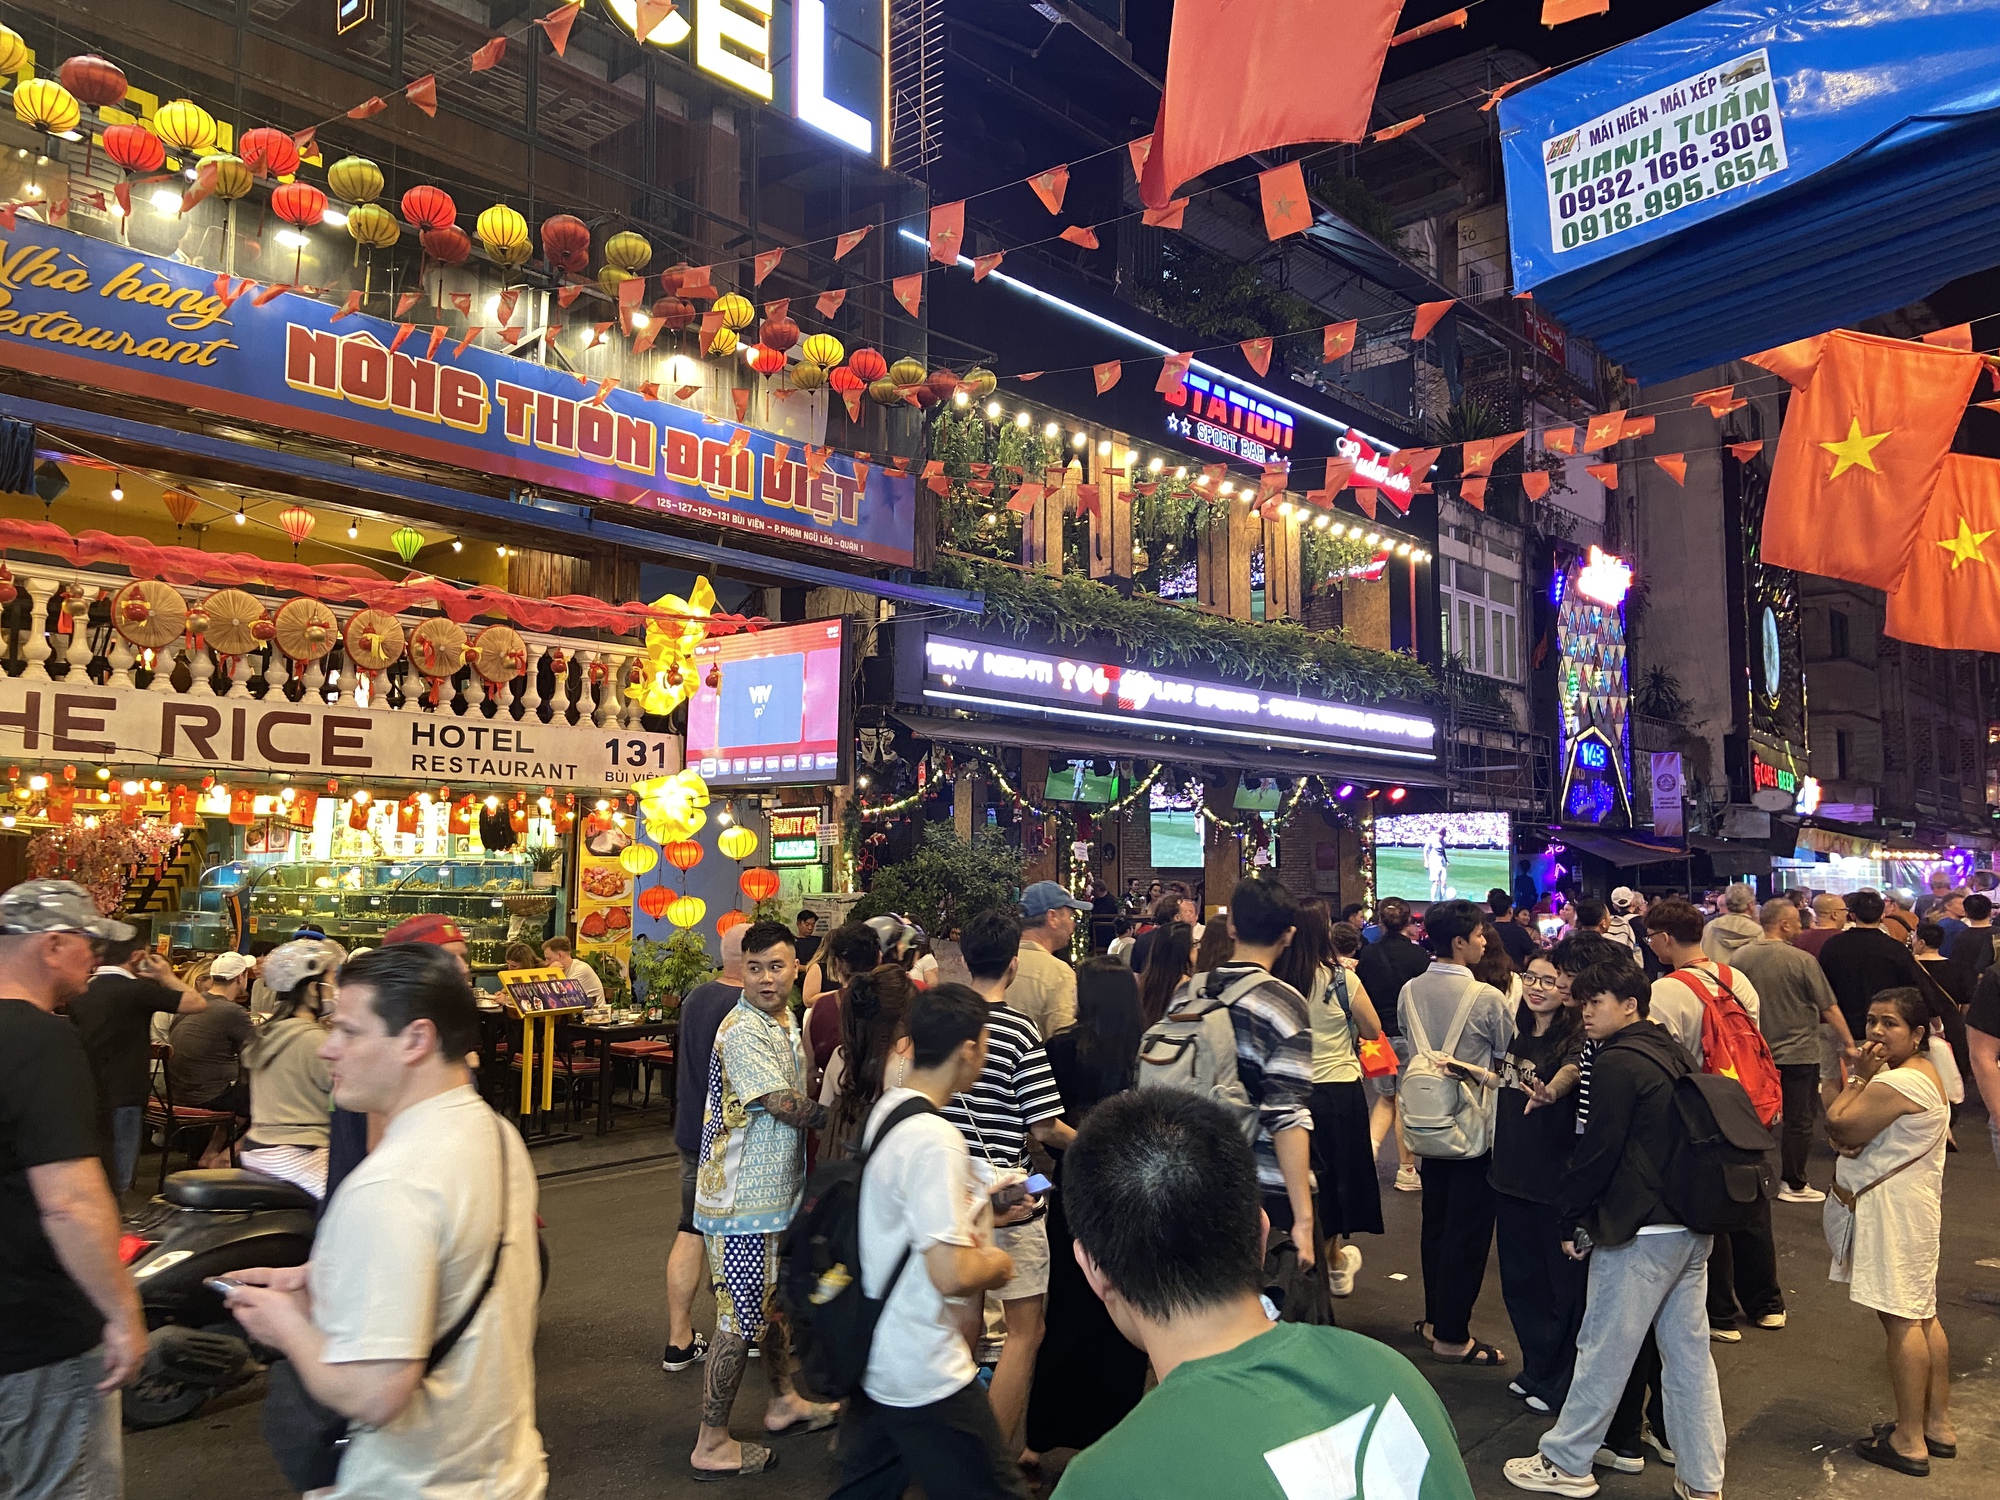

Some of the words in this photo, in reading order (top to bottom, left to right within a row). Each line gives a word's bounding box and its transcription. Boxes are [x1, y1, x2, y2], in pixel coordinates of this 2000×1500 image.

[1589, 121, 1615, 147] MÁI
[1617, 106, 1649, 136] HIÊN
[1660, 87, 1688, 116] MÁI
[1690, 73, 1717, 104] XẾP
[1674, 82, 1770, 143] TUẤN
[1559, 114, 1773, 219] 0932.166.309
[1561, 143, 1779, 249] 0918.995.654
[100, 262, 234, 331] hàng
[285, 322, 491, 434] NÔNG
[496, 379, 657, 477] THÔN
[661, 426, 755, 501] ĐẠI
[760, 453, 865, 527] VIỆT
[1197, 422, 1238, 452] SPORT
[1241, 438, 1266, 463] BAR
[656, 497, 730, 522] 125-127-129-131
[732, 512, 745, 526] BÙI
[747, 518, 765, 531] VIỆN
[774, 524, 802, 539] P.PHẠM
[160, 701, 374, 768] RICE
[411, 722, 534, 754] HOTEL
[605, 738, 665, 769] 131
[411, 754, 578, 780] RESTAURANT
[605, 769, 628, 783] BÙI
[1778, 769, 1795, 794] BEER
